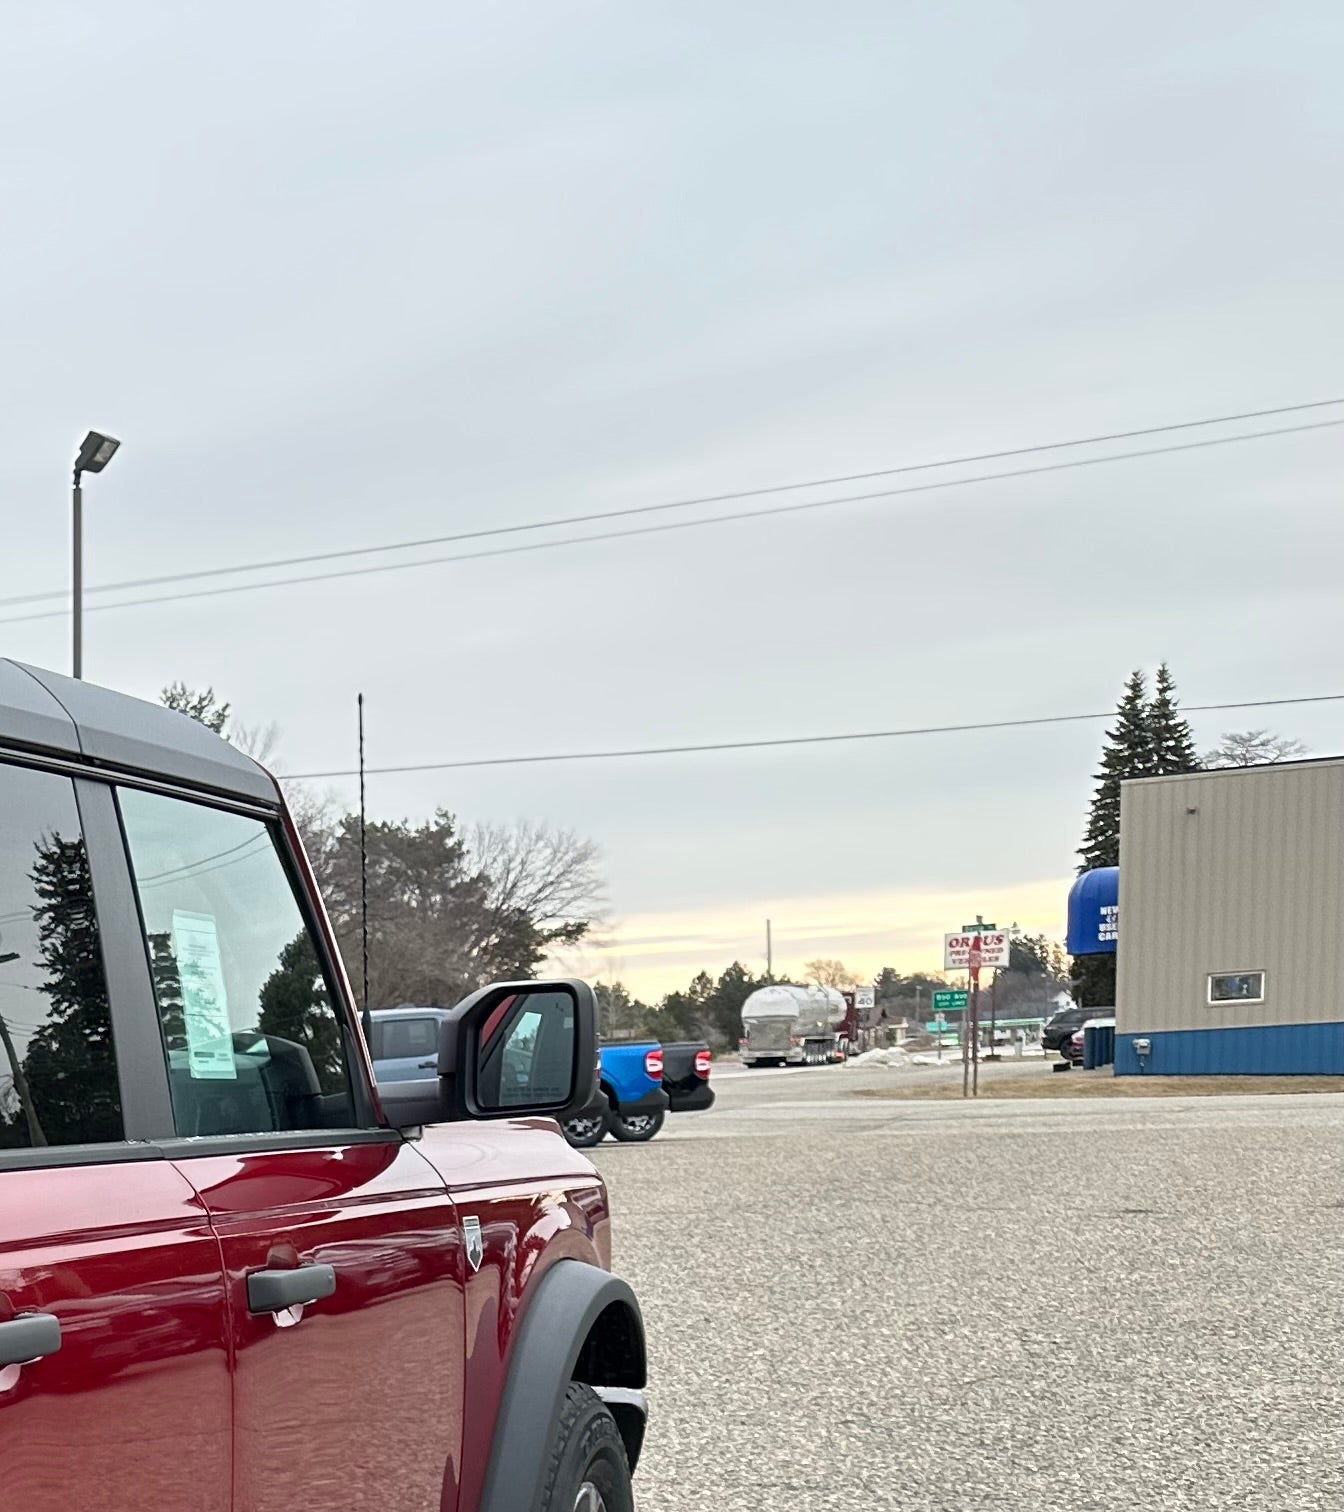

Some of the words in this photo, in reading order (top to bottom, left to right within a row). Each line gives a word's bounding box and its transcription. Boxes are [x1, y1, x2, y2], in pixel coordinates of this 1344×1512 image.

[1099, 923, 1118, 931] USE
[948, 934, 1005, 948] ORUS
[1098, 932, 1119, 941] CAR
